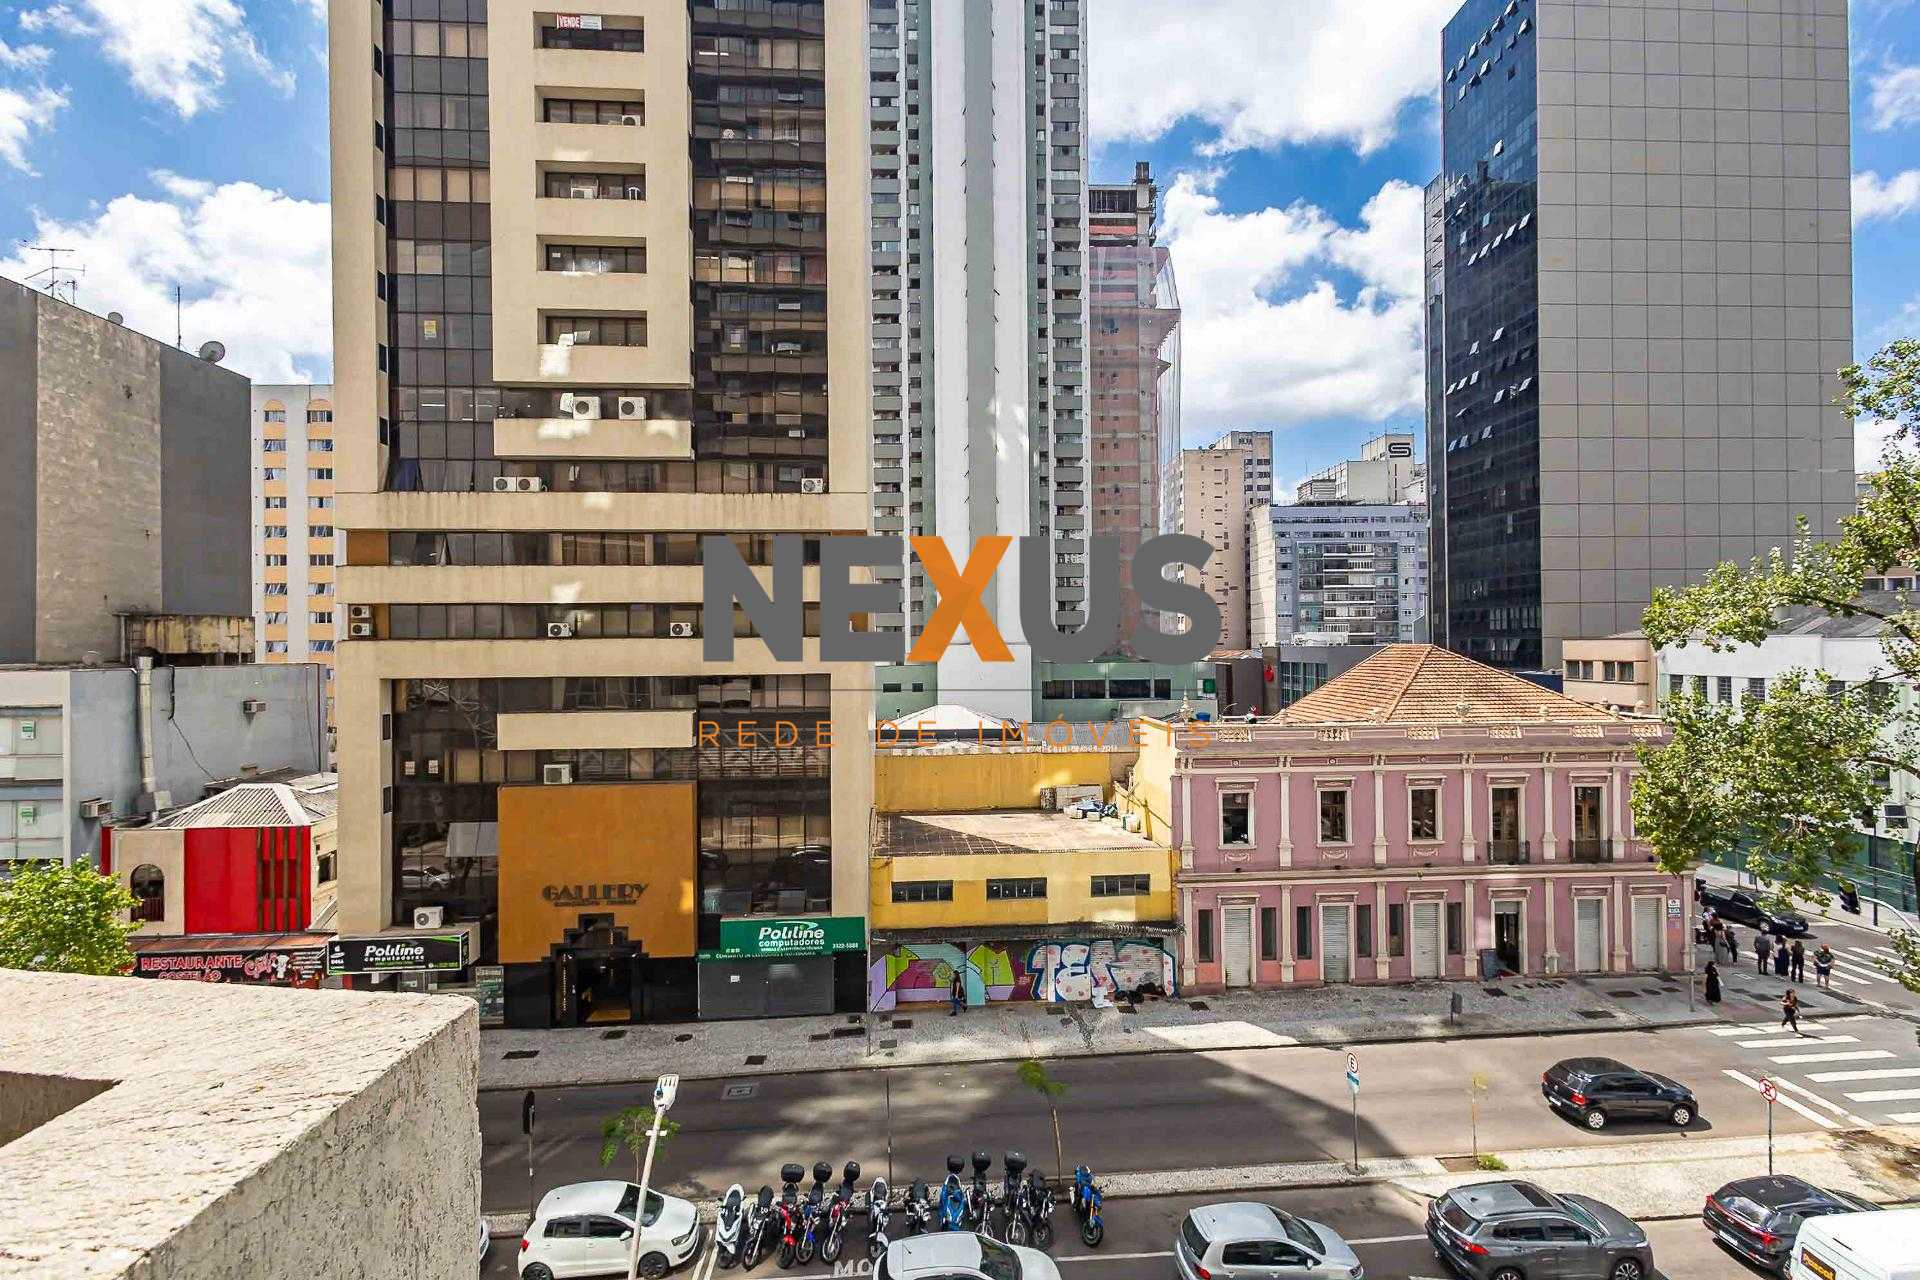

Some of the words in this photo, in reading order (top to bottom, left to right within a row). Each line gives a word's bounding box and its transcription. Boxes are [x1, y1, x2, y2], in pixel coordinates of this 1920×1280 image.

[559, 15, 580, 29] VENDE
[543, 883, 650, 901] GALLERY
[758, 938, 825, 947] computadores
[141, 954, 243, 970] RESTAURANTE
